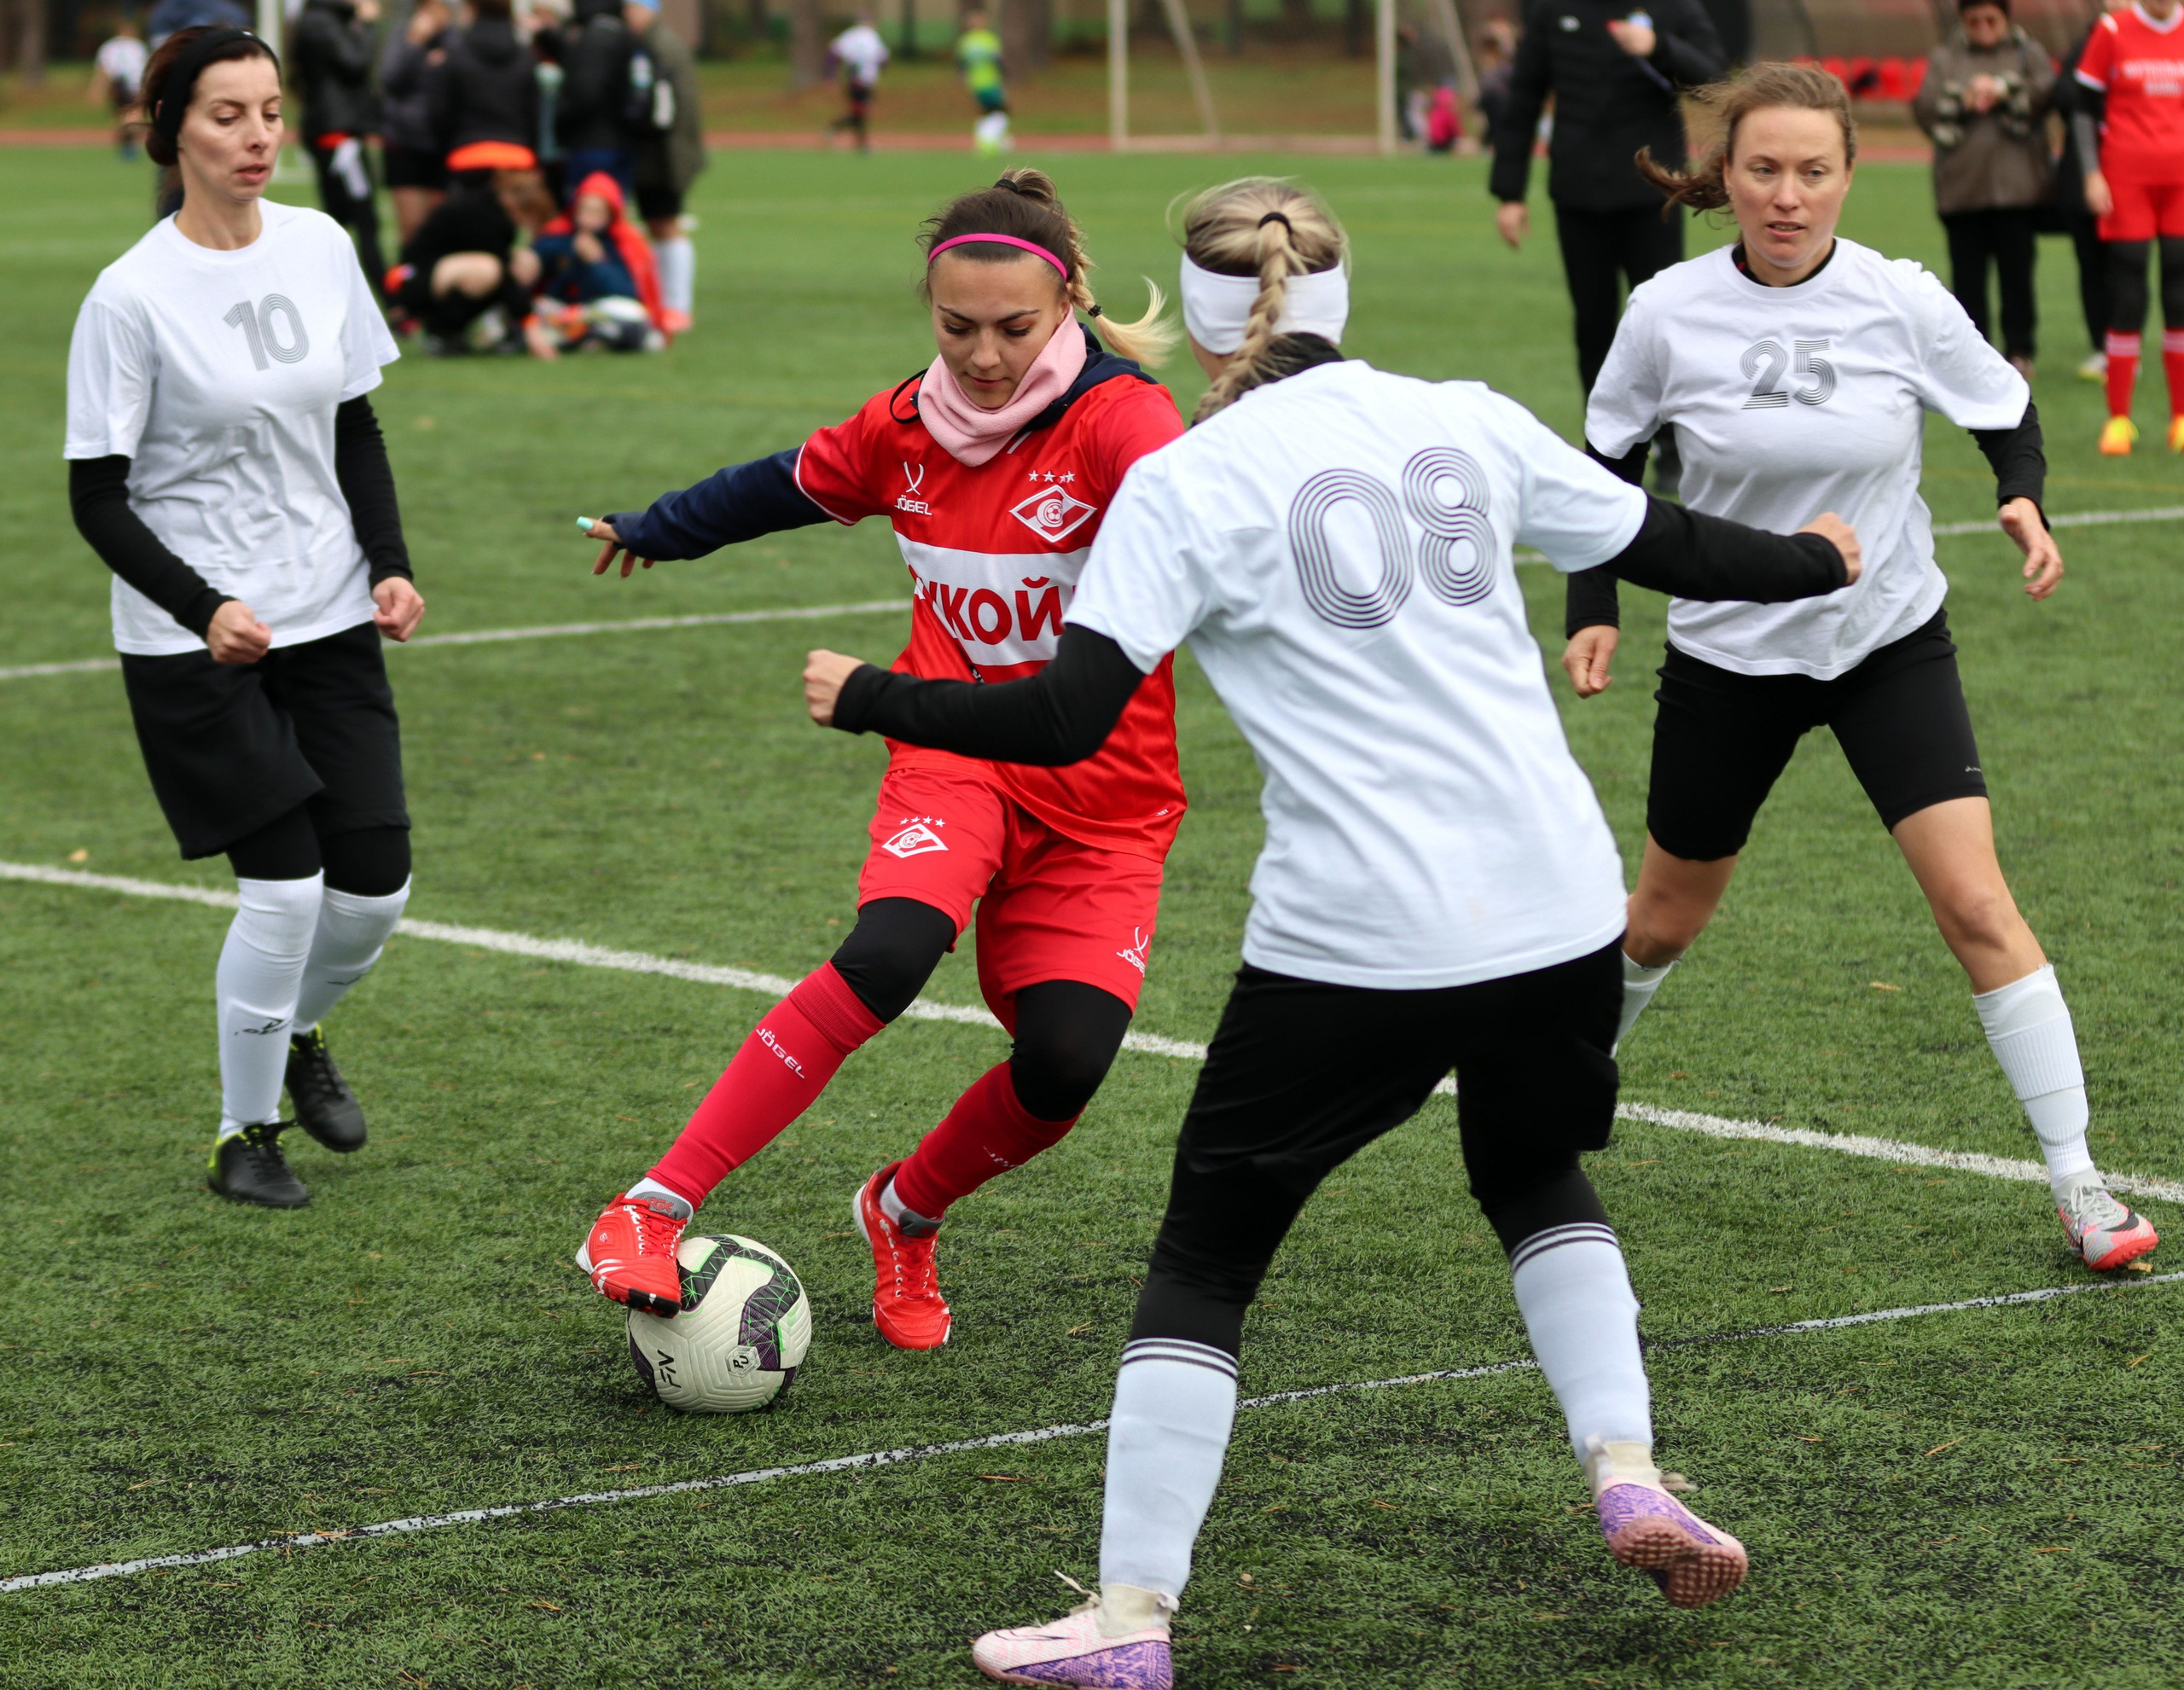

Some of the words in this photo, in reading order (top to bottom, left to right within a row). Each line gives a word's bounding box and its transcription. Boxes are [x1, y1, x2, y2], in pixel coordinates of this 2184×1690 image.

[223, 293, 310, 371] 10
[1739, 339, 1837, 409] 25
[1288, 446, 1498, 630] 08
[755, 1027, 805, 1079] JÖGEL
[732, 1355, 749, 1369] PU
